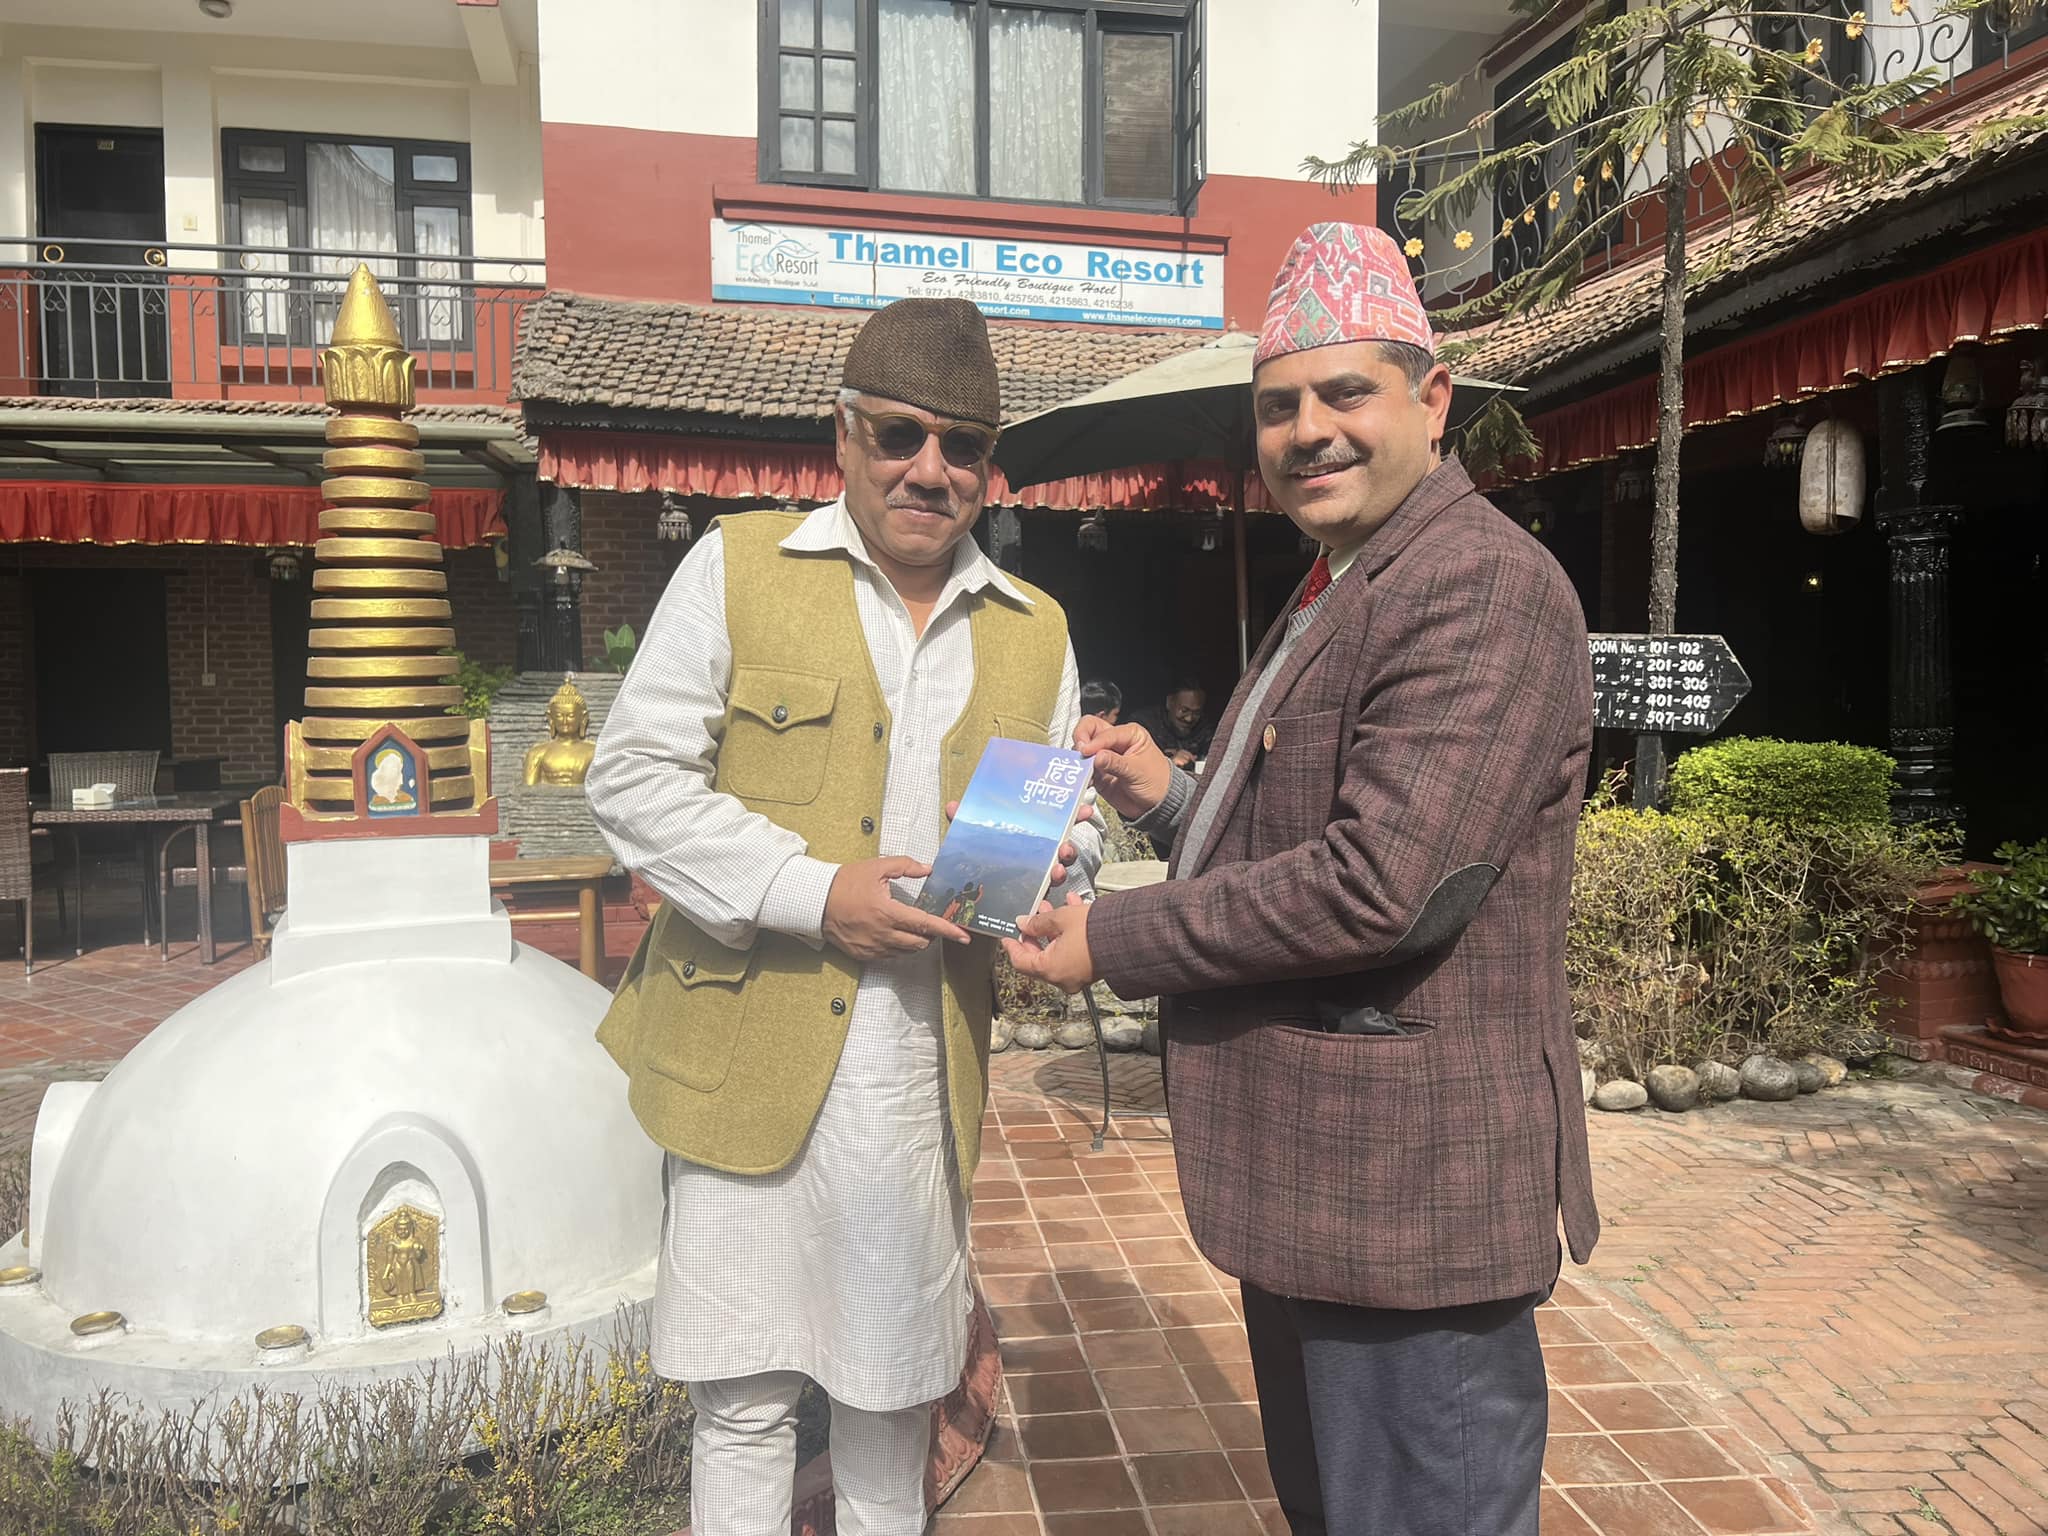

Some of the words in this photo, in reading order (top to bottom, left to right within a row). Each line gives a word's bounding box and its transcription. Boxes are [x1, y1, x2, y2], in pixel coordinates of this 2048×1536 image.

[737, 231, 772, 245] Thamel
[735, 244, 776, 272] Eco
[776, 253, 818, 275] Resort
[828, 232, 969, 268] Thamel
[996, 244, 1063, 275] Eco
[1087, 251, 1204, 284] Resort
[922, 272, 948, 284] Eco
[953, 274, 1011, 289] Friendly
[1017, 278, 1074, 293] Boutique
[1080, 282, 1117, 295] Hotel
[906, 287, 924, 296] Tel:
[833, 294, 864, 305] Email:
[1649, 641, 1701, 655] 101-102
[1647, 659, 1705, 672] 201-206
[1648, 675, 1709, 691] 301-306
[1645, 694, 1712, 709] 401-405
[1645, 710, 1706, 726] 507-511
